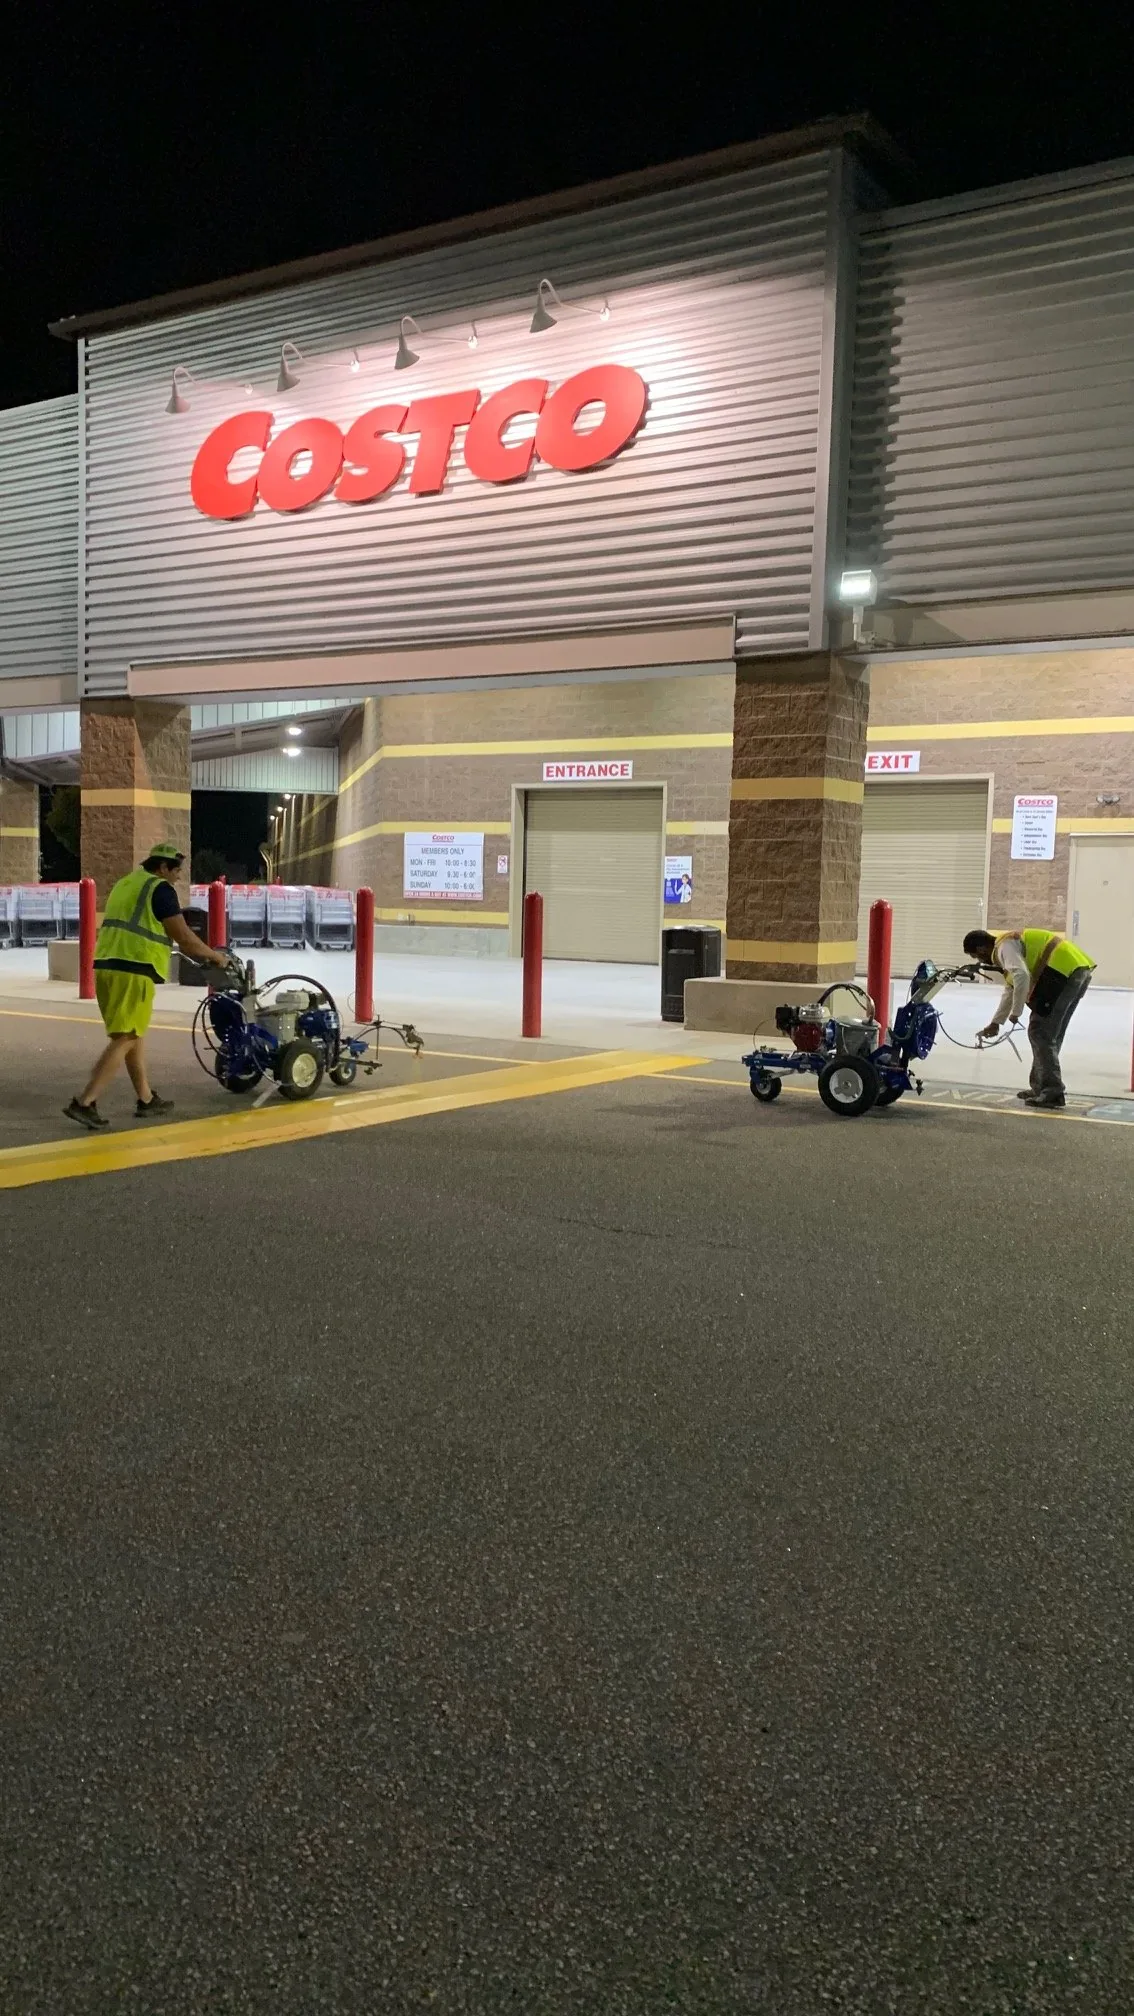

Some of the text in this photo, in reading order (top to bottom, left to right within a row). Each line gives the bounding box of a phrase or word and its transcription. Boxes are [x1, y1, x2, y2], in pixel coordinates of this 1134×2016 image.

[191, 364, 648, 519] COSTCO
[868, 755, 913, 769] EXIT
[546, 763, 629, 778] ENTRANCE
[1017, 798, 1054, 806] COSTCO
[421, 847, 464, 855] MEMBERS ONLY
[445, 859, 460, 867] 10:00
